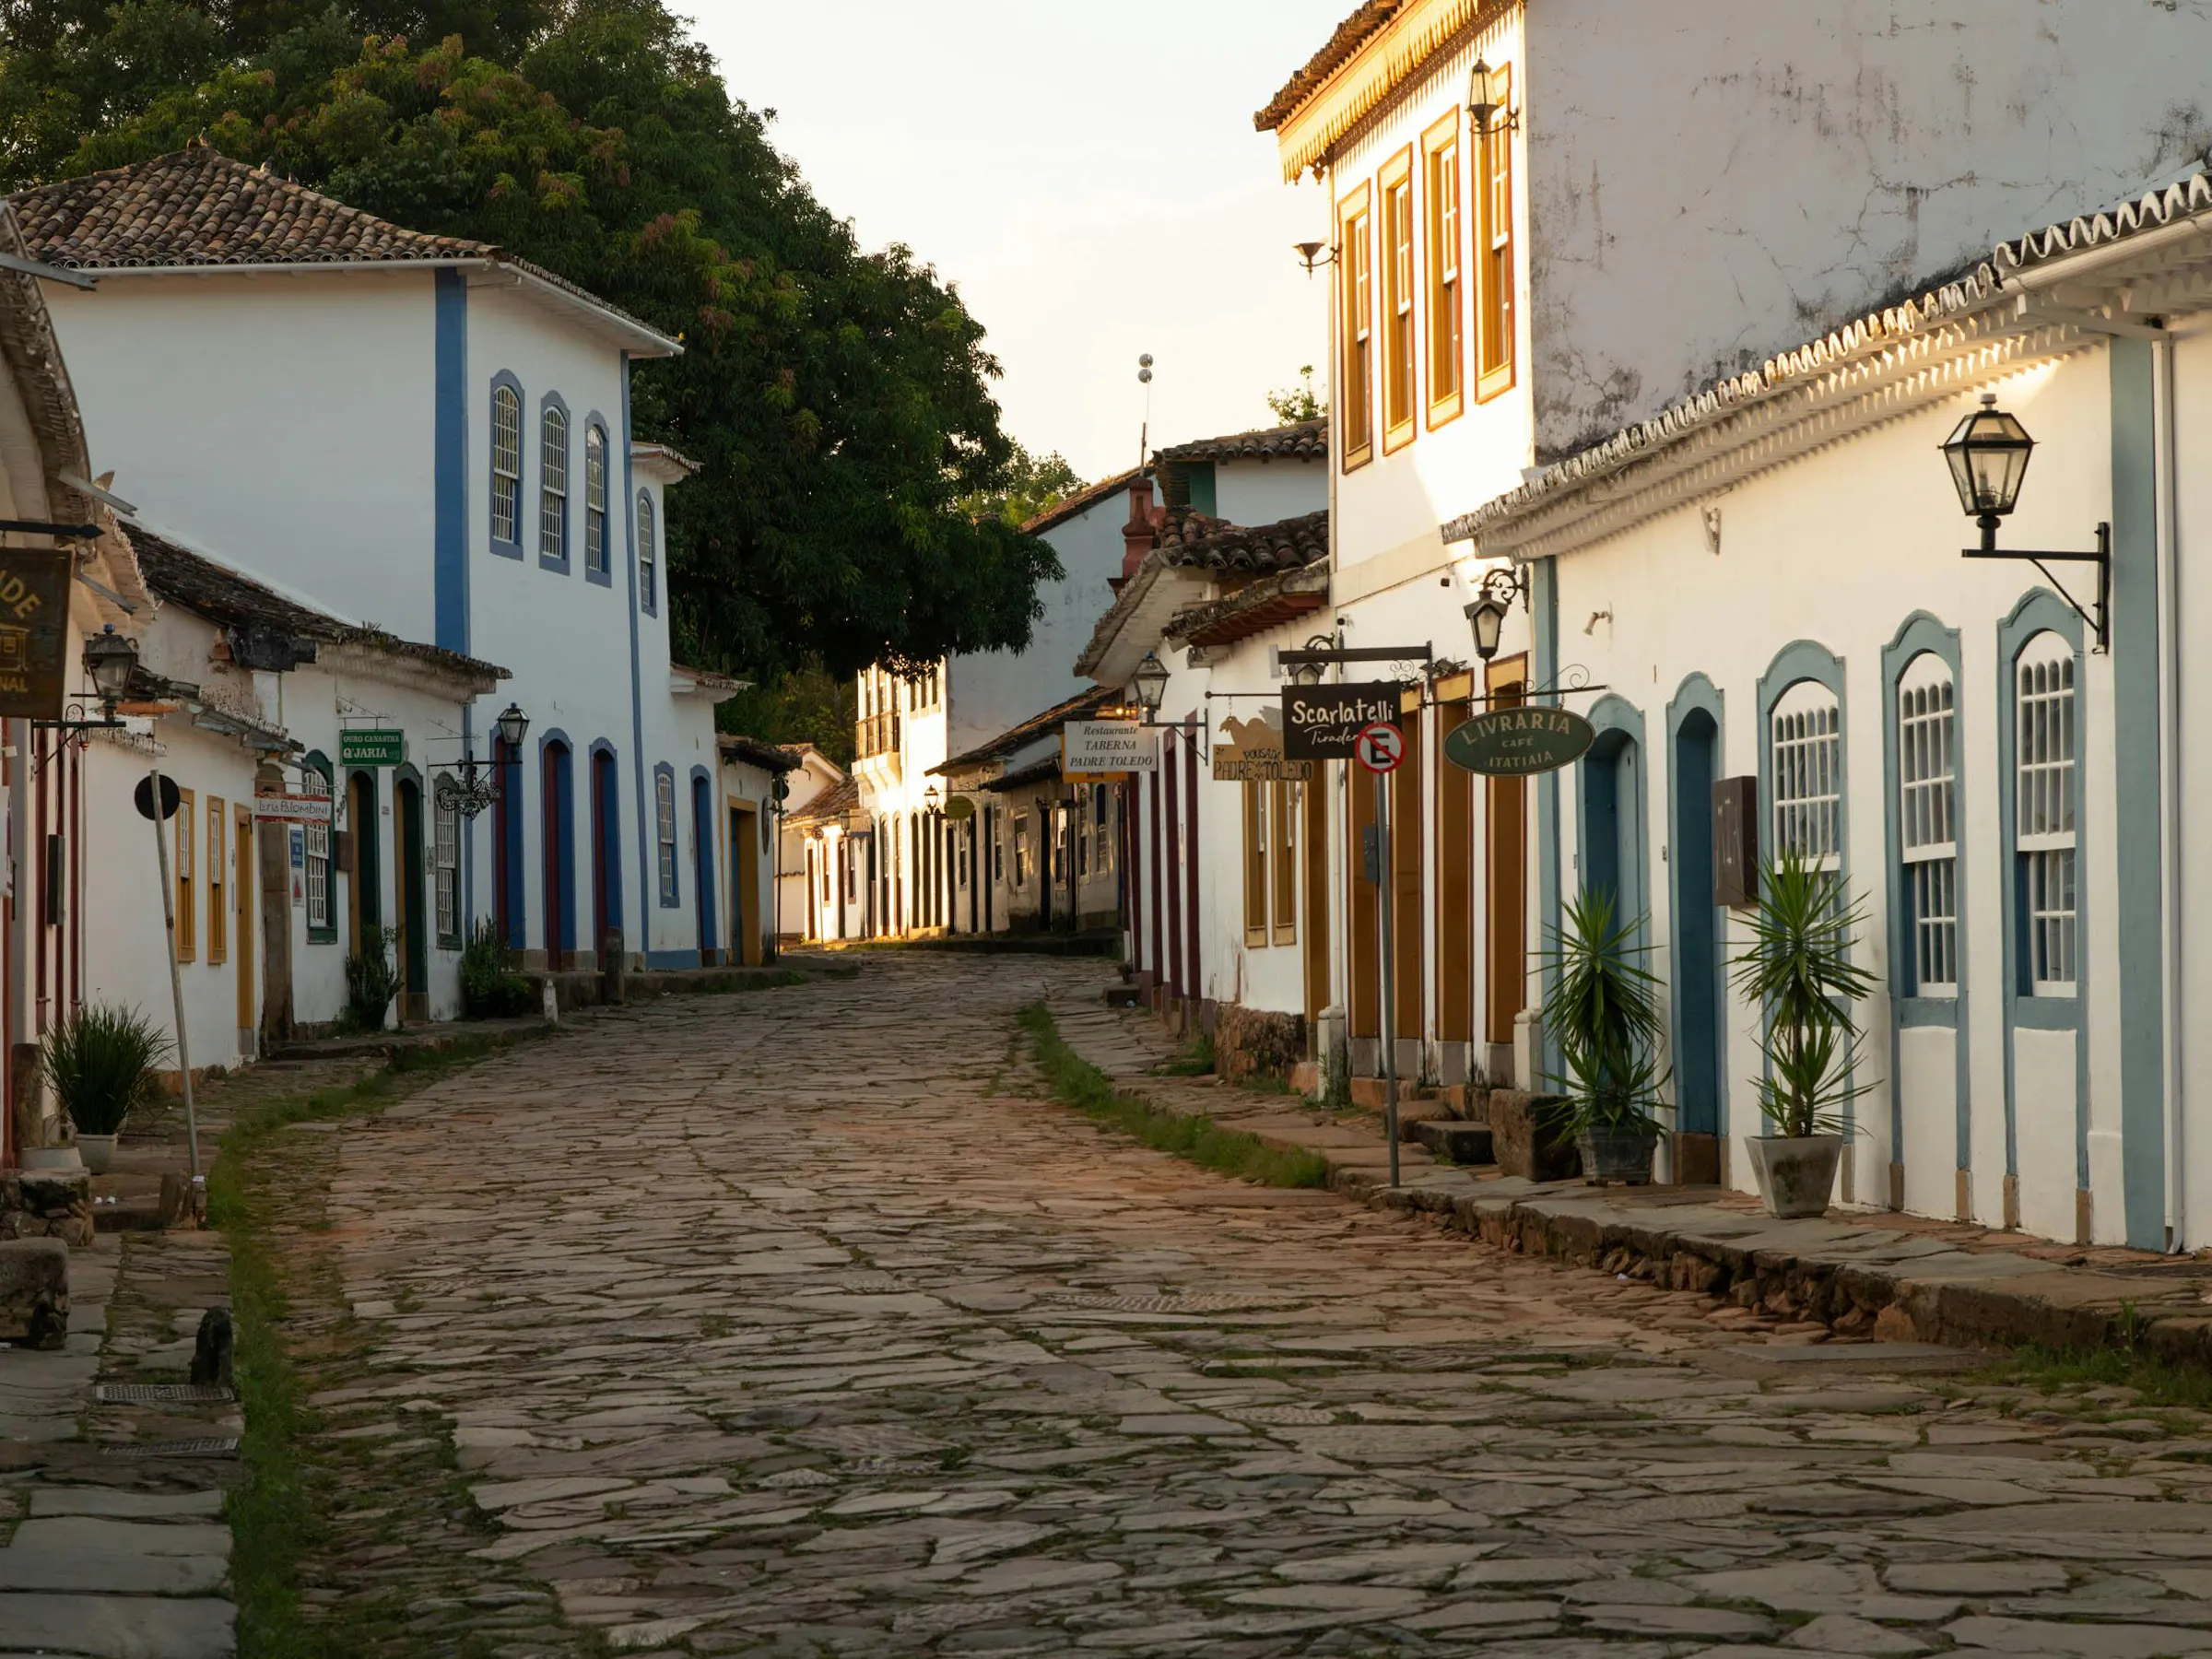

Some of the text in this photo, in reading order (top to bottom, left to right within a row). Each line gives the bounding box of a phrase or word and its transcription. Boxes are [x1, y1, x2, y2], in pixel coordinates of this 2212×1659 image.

[1291, 698, 1394, 724] Scarlatelli
[1084, 726, 1138, 735] Restaurante
[1460, 712, 1571, 745] LIVRARIA
[1085, 740, 1136, 751] TABERNA
[1501, 735, 1535, 748] CAFÉ
[1070, 756, 1152, 767] PADRE TOLEDO
[1488, 750, 1553, 768] ITATIAIA
[1214, 760, 1312, 781] PADRE TOLEDO
